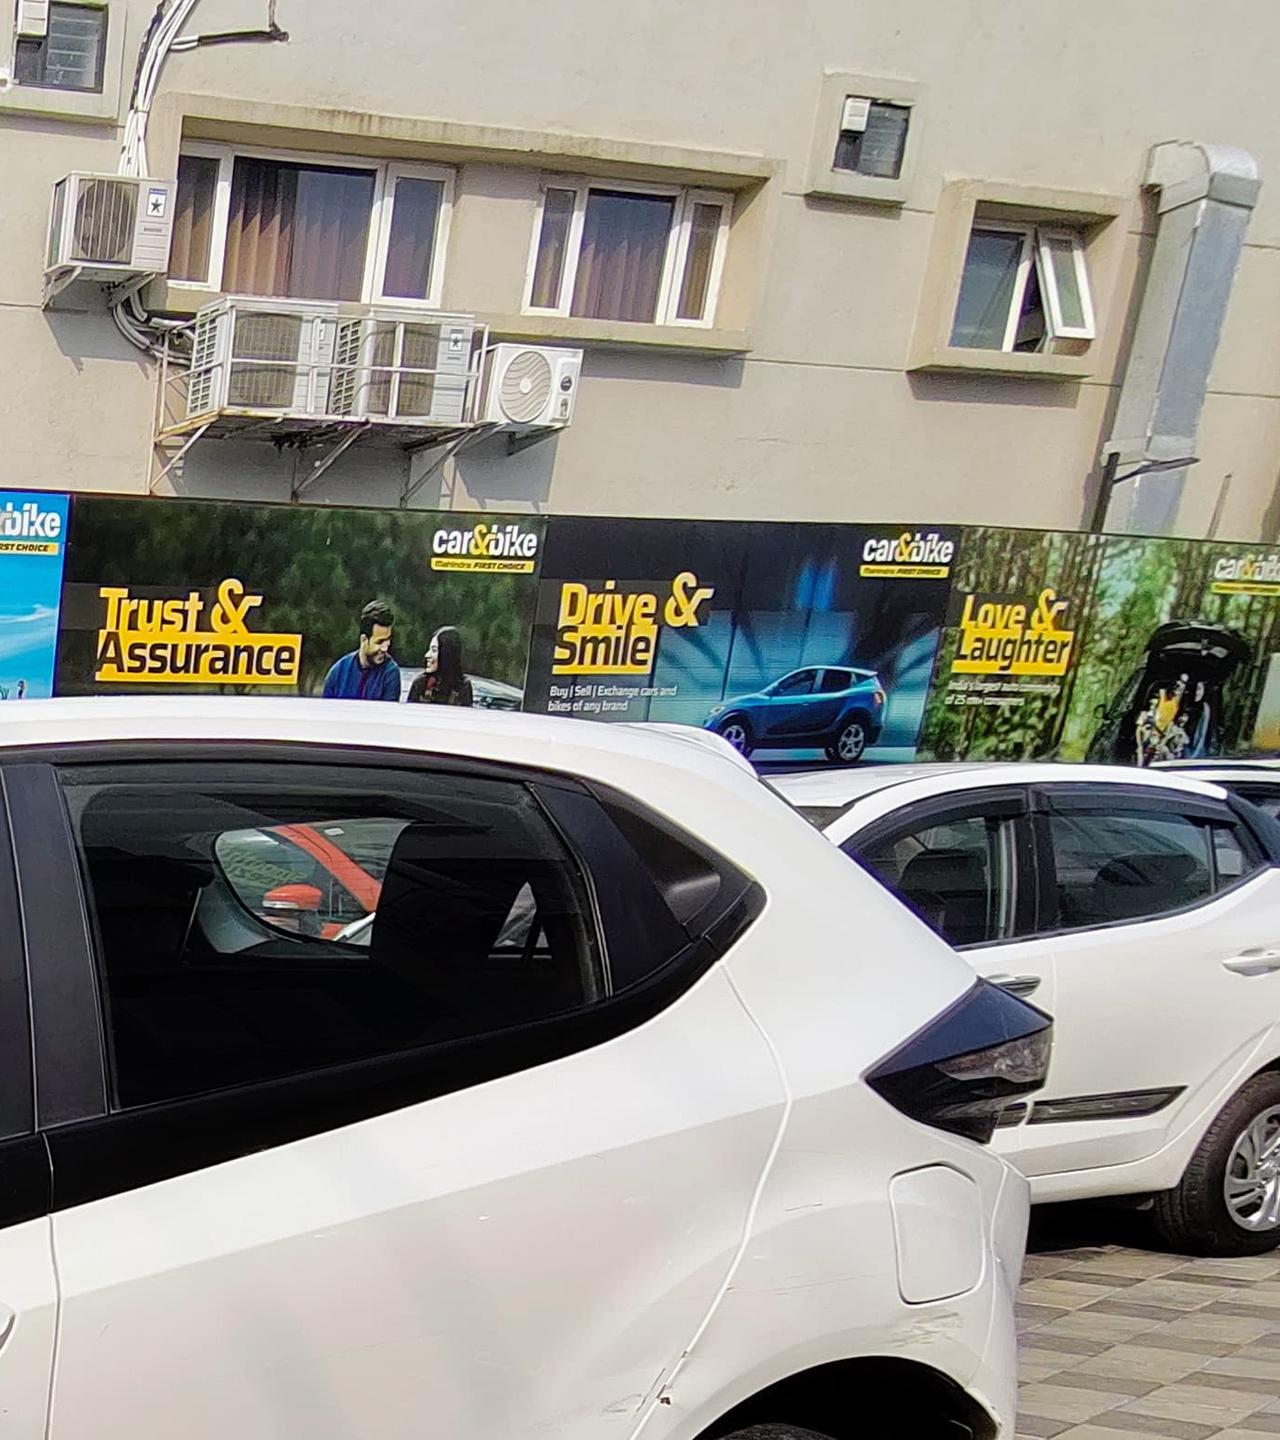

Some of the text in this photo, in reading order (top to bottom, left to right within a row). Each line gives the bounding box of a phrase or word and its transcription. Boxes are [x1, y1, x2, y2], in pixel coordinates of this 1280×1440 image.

[16, 543, 49, 552] CHOICE
[433, 524, 537, 557] car&bike
[863, 532, 954, 563] car&bike
[1214, 551, 1280, 581] car&bik
[100, 578, 263, 633] Trust &
[558, 572, 715, 627] Drive &
[960, 588, 1069, 631] Love &
[96, 632, 295, 675] Assurance
[552, 624, 651, 666] Smile
[957, 626, 1070, 671] Laughter
[550, 685, 569, 699] Buy
[575, 685, 592, 697] Sell
[597, 686, 638, 699] Exchange
[583, 702, 601, 713] any
[602, 700, 629, 712] brand
